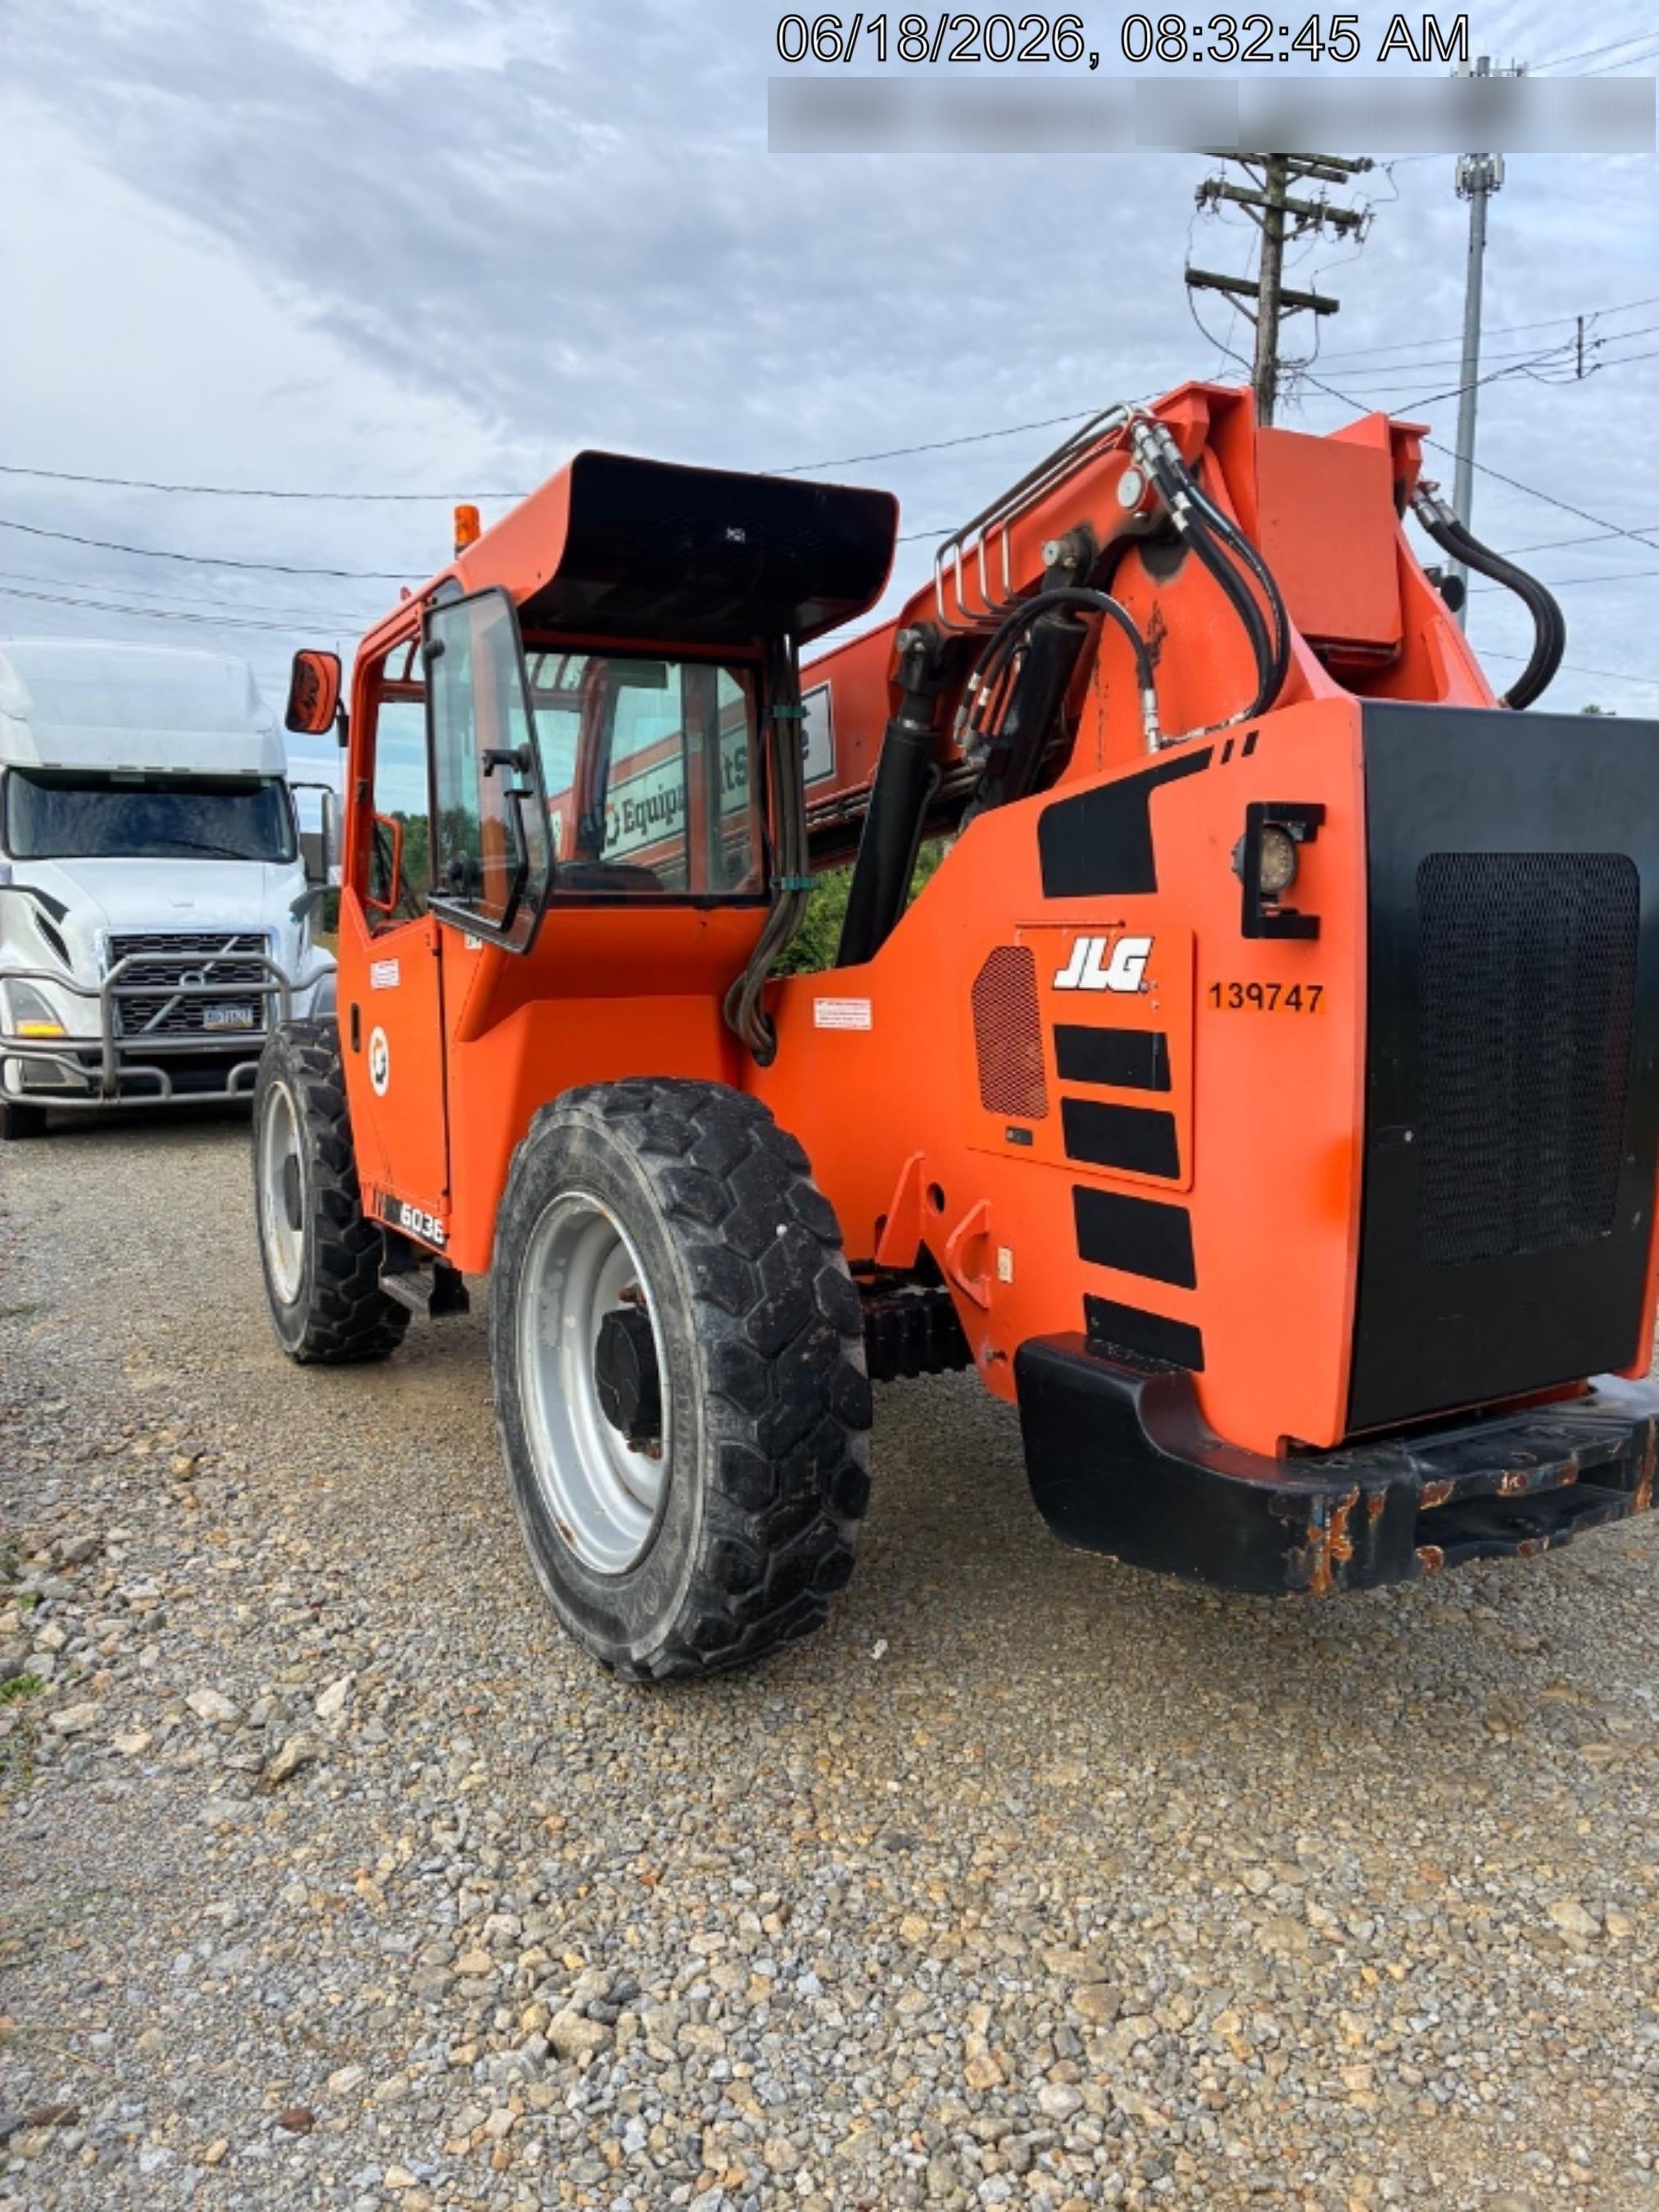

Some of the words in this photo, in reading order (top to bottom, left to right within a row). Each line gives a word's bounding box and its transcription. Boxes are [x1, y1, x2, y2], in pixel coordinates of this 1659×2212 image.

[1052, 935, 1155, 994] JLG
[1208, 981, 1324, 1013] 139747
[399, 1201, 446, 1244] 6036
